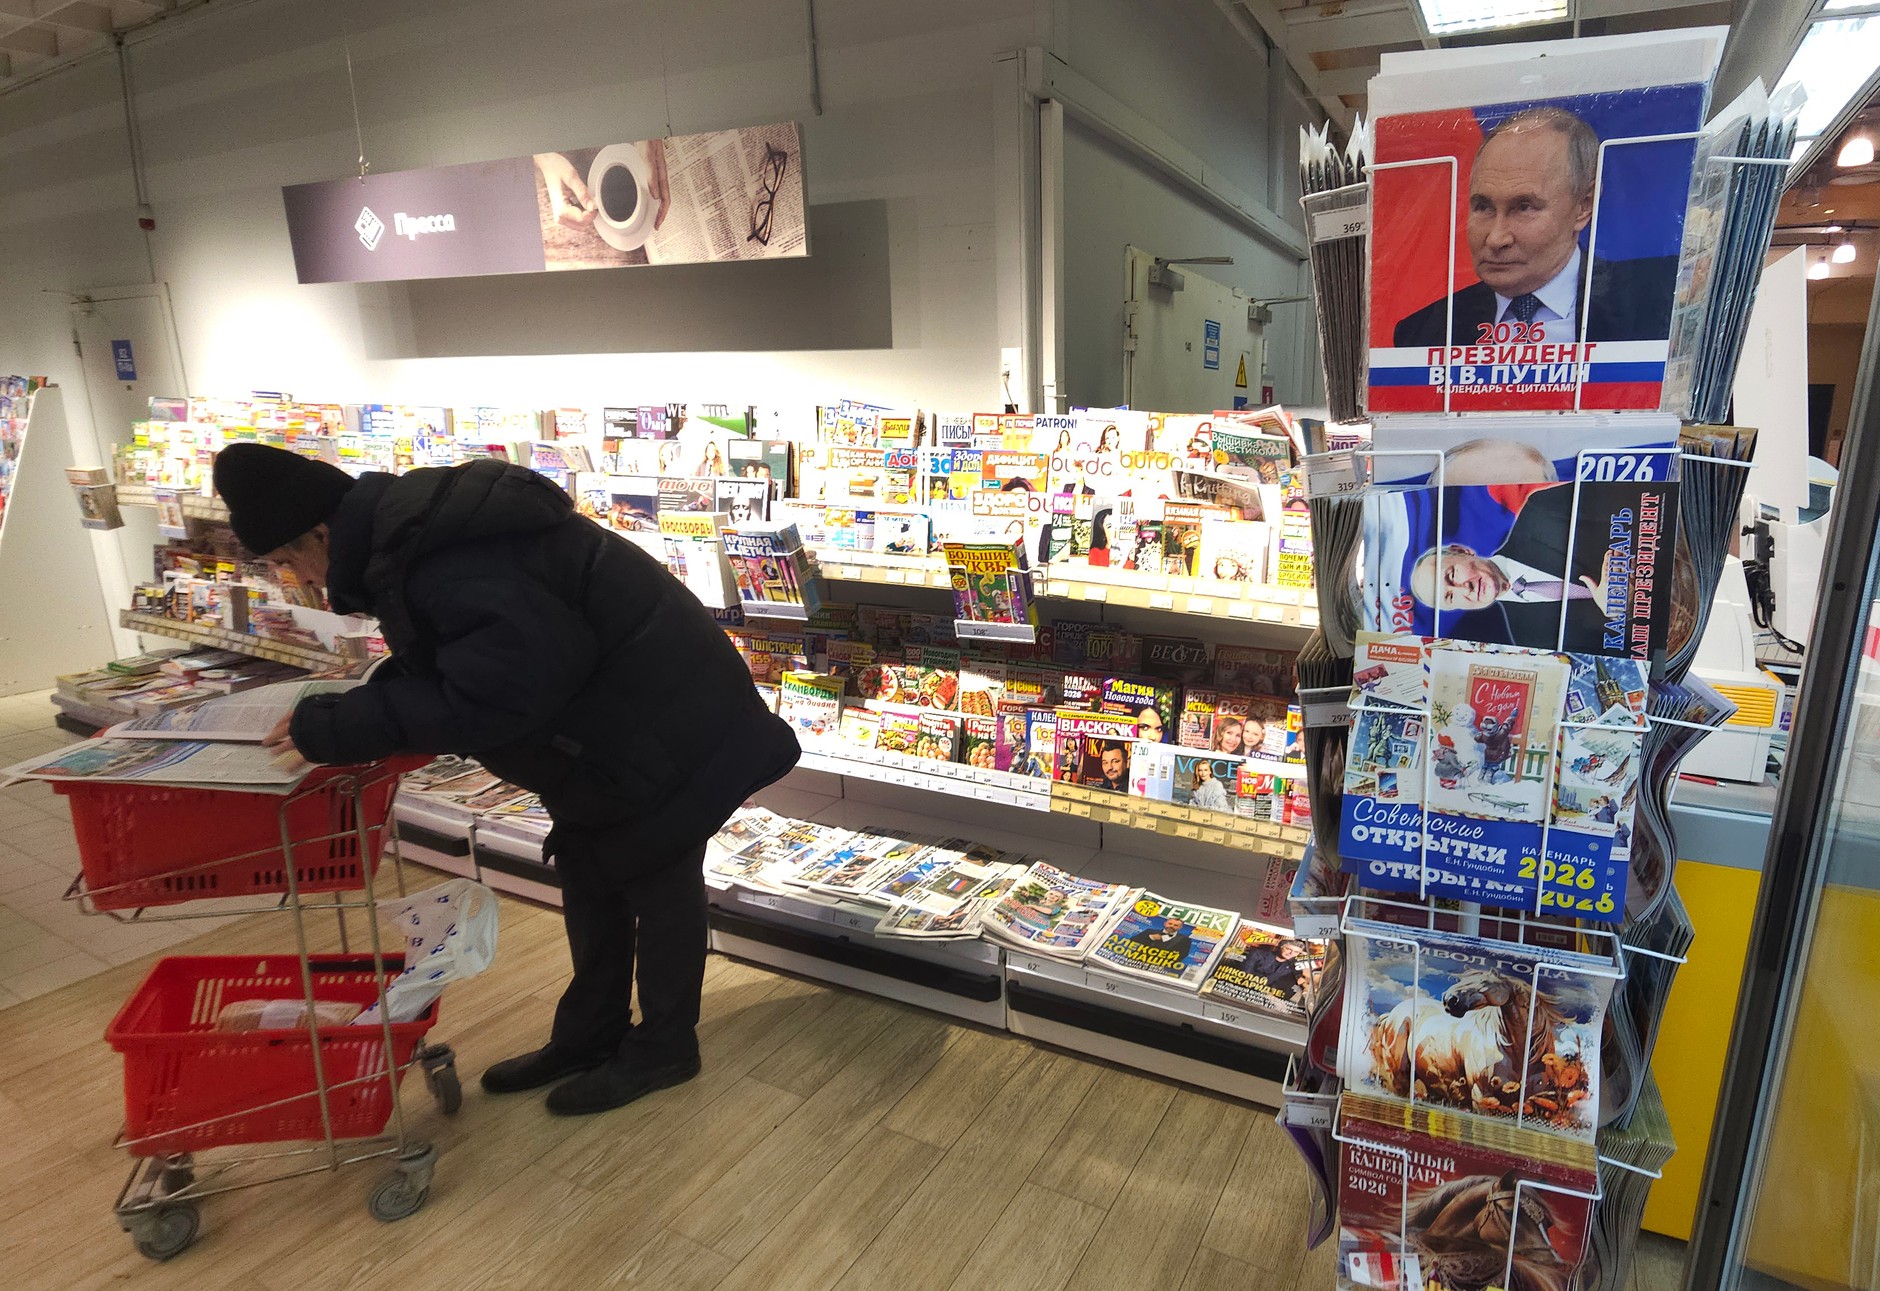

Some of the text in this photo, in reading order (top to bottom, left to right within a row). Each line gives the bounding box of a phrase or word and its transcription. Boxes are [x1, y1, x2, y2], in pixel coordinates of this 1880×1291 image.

[393, 212, 456, 241] Пресса
[1475, 321, 1546, 346] 2026
[1427, 343, 1597, 366] ПРЕЗИДЕНТ
[1459, 366, 1484, 385] В.
[1490, 363, 1592, 385] ПУТИН
[1505, 384, 1513, 394] С
[1582, 454, 1654, 482] 2026
[660, 520, 714, 537] КРОССВОРДЫ
[724, 534, 772, 547] КРУПНАЯ
[948, 551, 1011, 561] БОЛЬШИЕ
[1633, 492, 1662, 620] ПРЕЗИДЕНТ
[1603, 507, 1635, 651] КАЛЕНДАРЬ
[751, 638, 805, 655] ТОЛСТЯЧОК
[1370, 645, 1398, 655] ДАЧА
[1104, 691, 1154, 706] Нового года
[1111, 679, 1155, 698] Магия
[1475, 682, 1489, 704] С
[1217, 699, 1249, 716] Все
[1061, 720, 1135, 738] BLACKPINK
[1353, 798, 1485, 840] Советские
[1351, 825, 1508, 865] открытки
[1462, 860, 1505, 875] Гундобин
[1517, 856, 1596, 890] 2026
[1481, 891, 1525, 903] Гундобин
[1157, 901, 1229, 931] ТЕЛЕК
[1102, 941, 1186, 971] КОМАШКО
[1108, 933, 1181, 961] АЛЕКСЕЙ
[1027, 962, 1038, 972] 62
[1376, 939, 1573, 981] СИМВОЛ ГОДА
[1105, 981, 1117, 992] 59
[1213, 971, 1286, 999] ЦИСКАРИДЗЕ:
[1217, 965, 1269, 986] НИКОЛАЙ
[1221, 1011, 1236, 1022] 159
[1350, 1150, 1445, 1186] КАЛЕНДАРЬ
[1348, 1175, 1387, 1197] 2026
